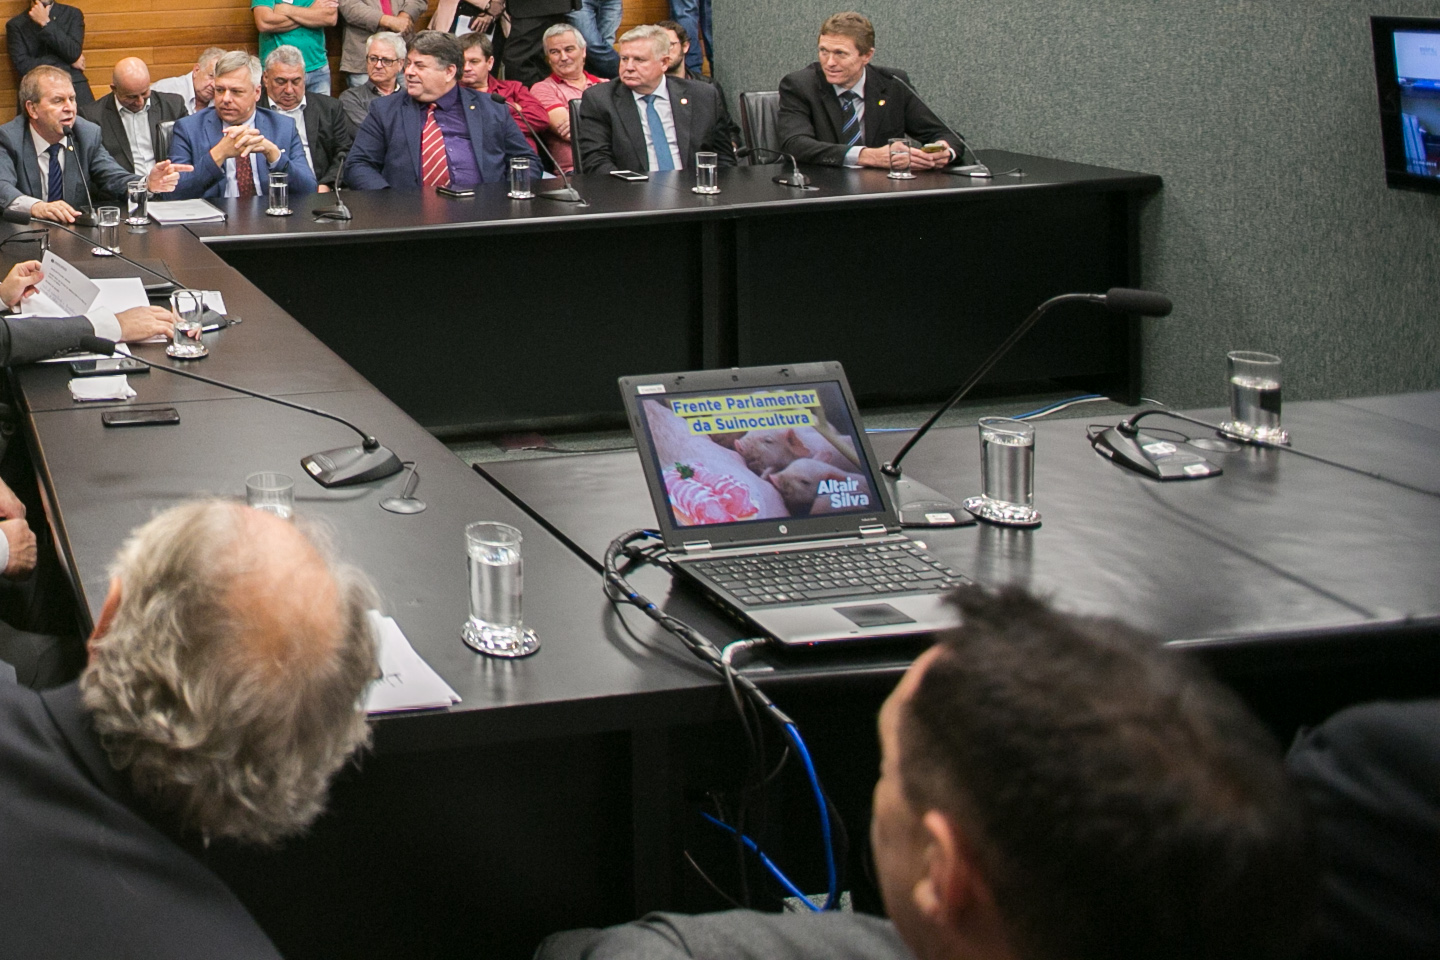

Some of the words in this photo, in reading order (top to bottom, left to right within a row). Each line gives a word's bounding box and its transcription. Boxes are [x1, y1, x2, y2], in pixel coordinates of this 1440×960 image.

[672, 400, 722, 414] Frente
[726, 393, 816, 410] Parlamentar
[693, 419, 711, 432] da
[716, 413, 810, 430] Suinocultura
[817, 477, 859, 495] Altair
[830, 492, 870, 508] Silva
